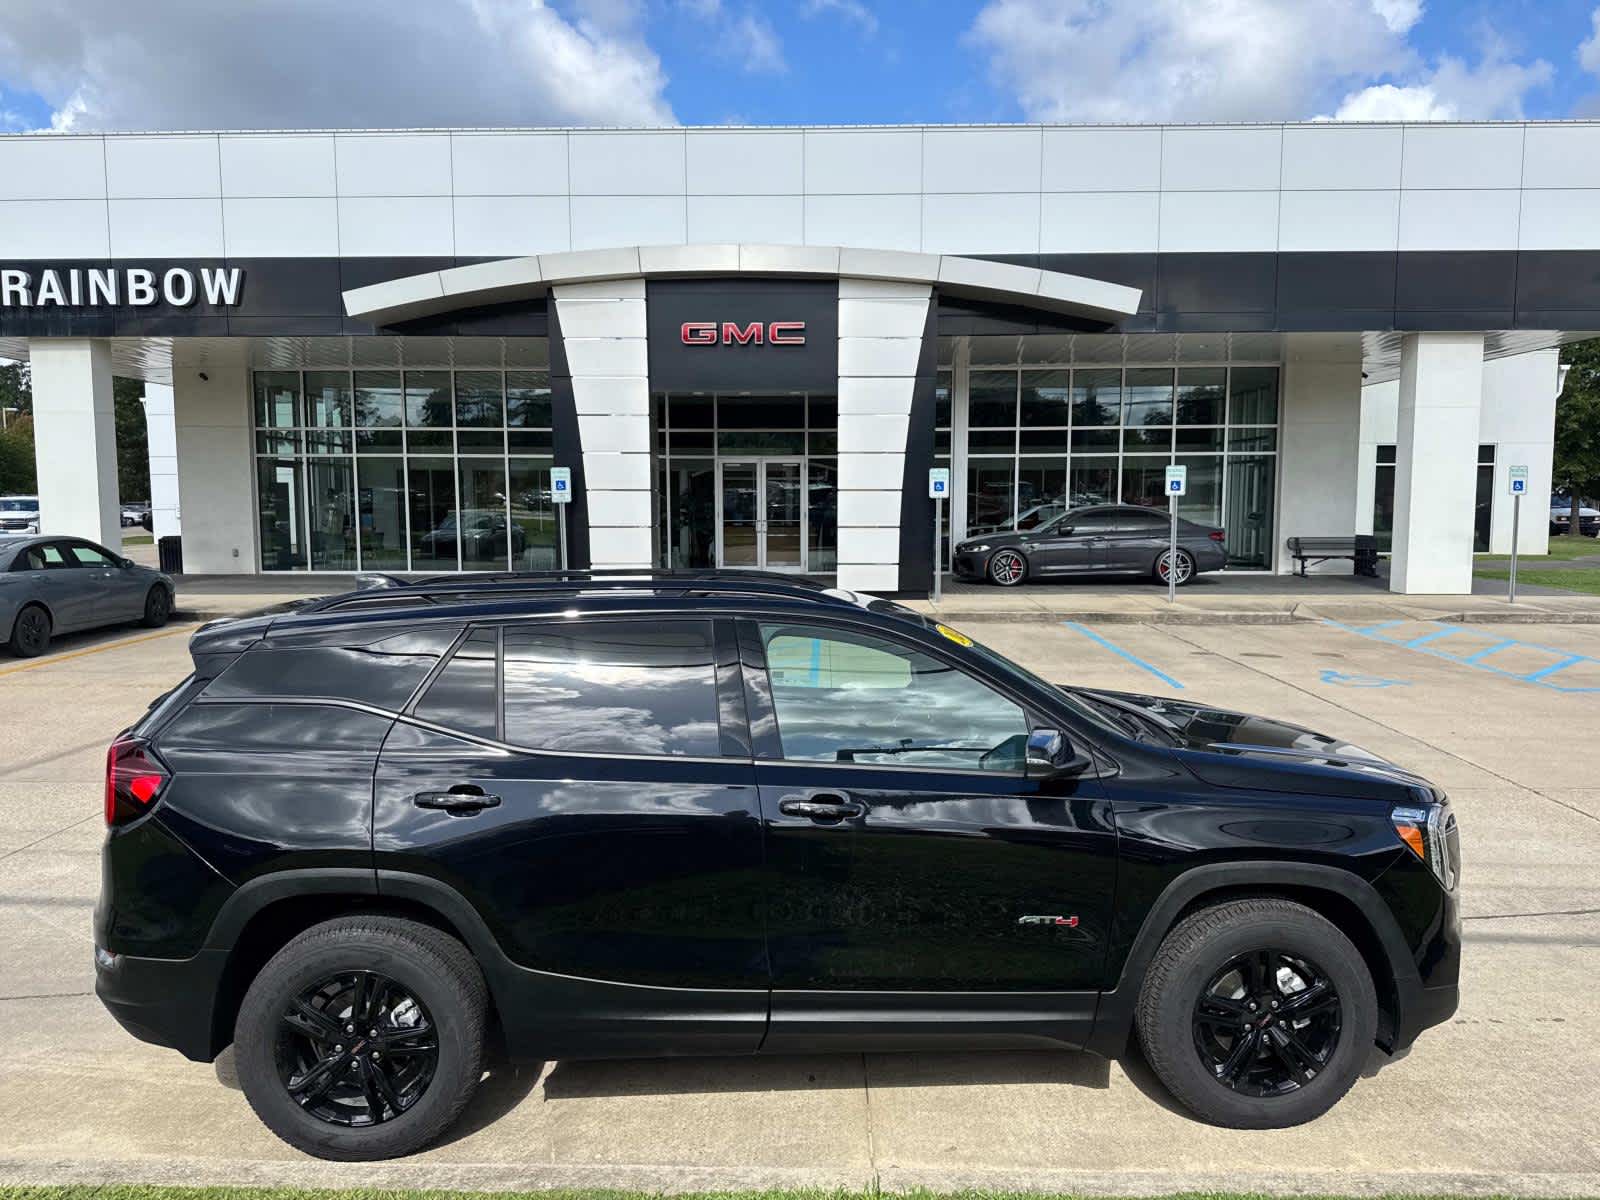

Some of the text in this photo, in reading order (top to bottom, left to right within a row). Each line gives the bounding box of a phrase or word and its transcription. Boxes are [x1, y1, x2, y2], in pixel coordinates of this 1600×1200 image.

[1, 267, 242, 306] RAINBOW
[680, 322, 806, 346] GMC
[1018, 915, 1079, 928] AT4
